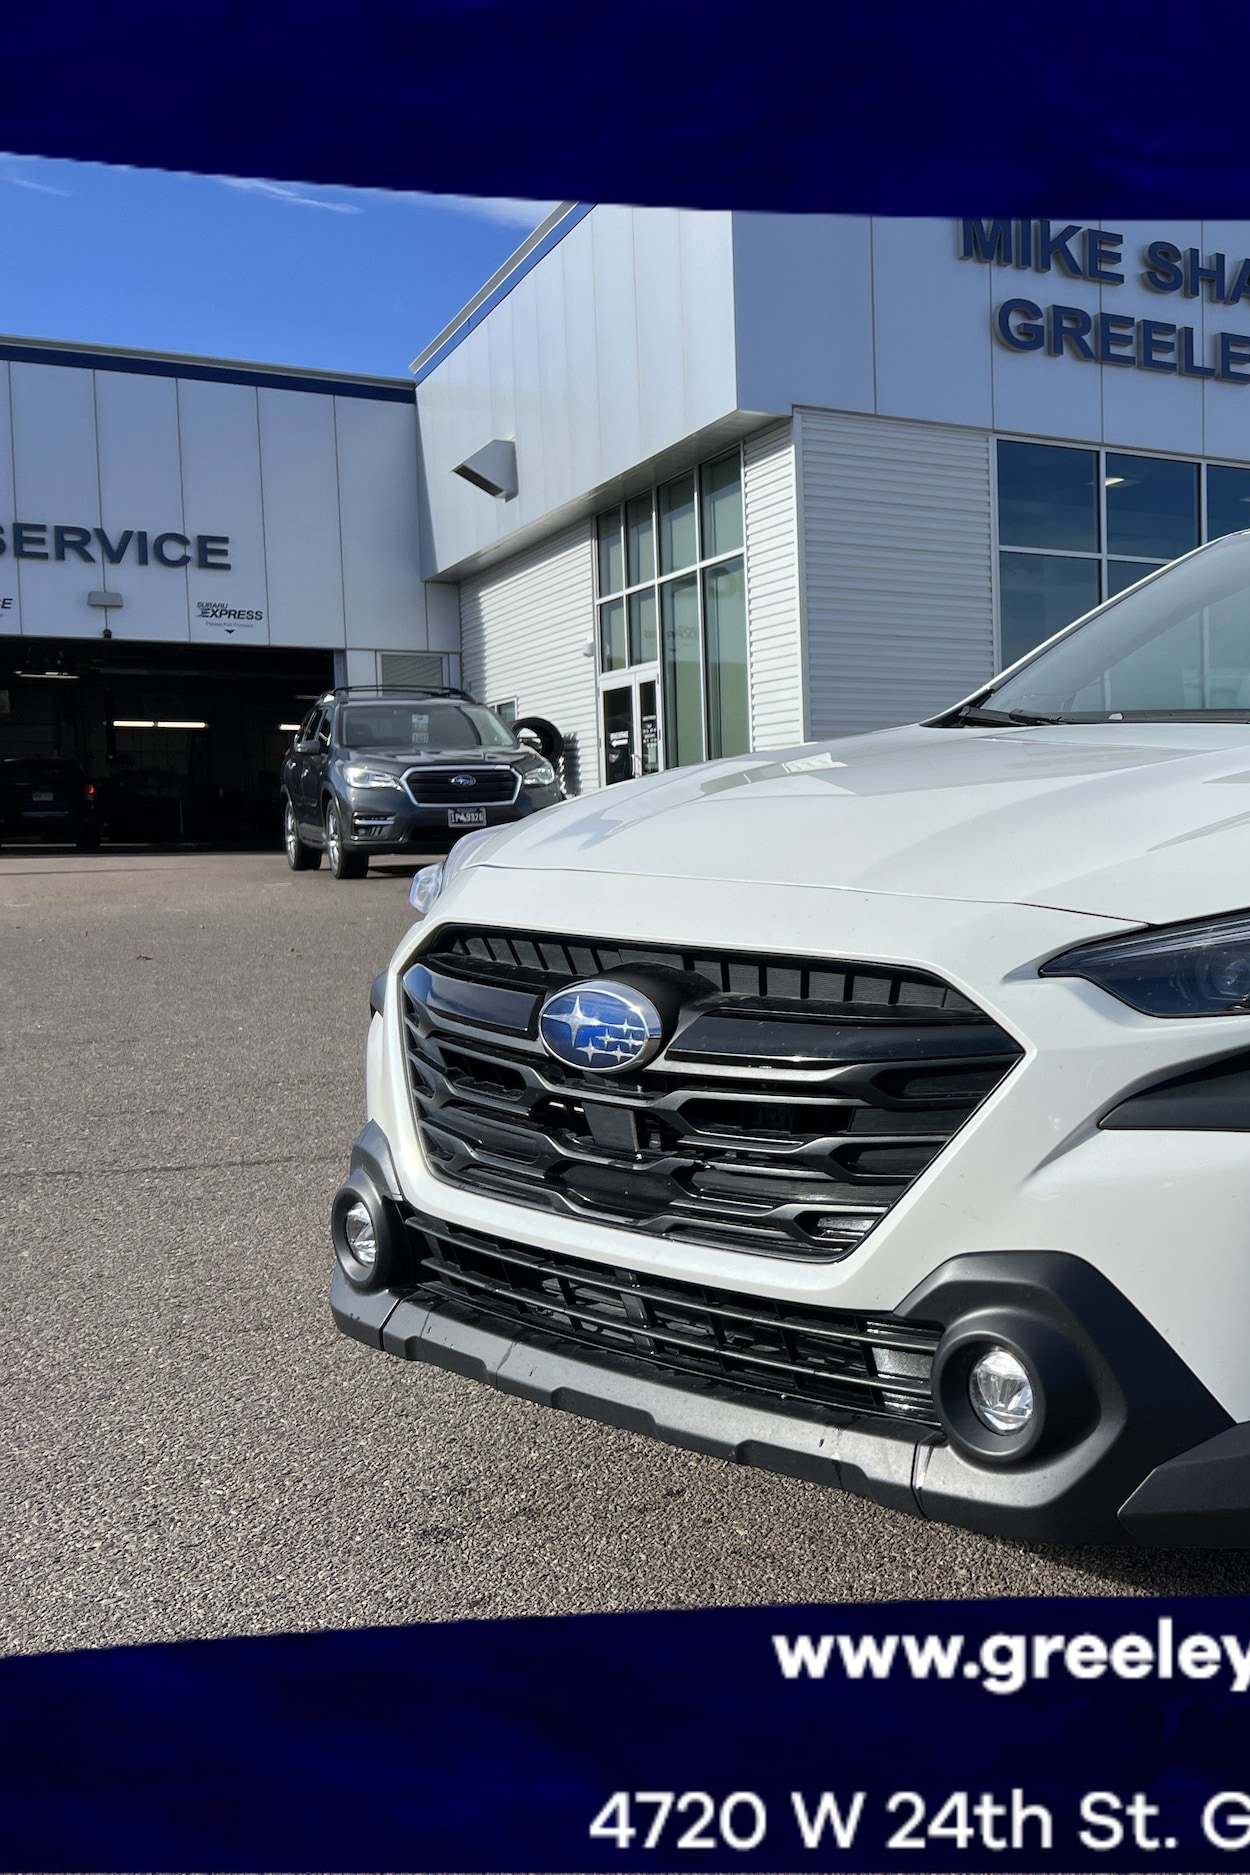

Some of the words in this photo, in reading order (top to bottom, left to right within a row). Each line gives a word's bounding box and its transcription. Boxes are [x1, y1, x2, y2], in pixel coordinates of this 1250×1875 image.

[958, 217, 1125, 286] MIKE
[0, 522, 232, 571] ERVICE
[197, 601, 228, 609] SUBARU
[197, 608, 263, 621] EXPRESS
